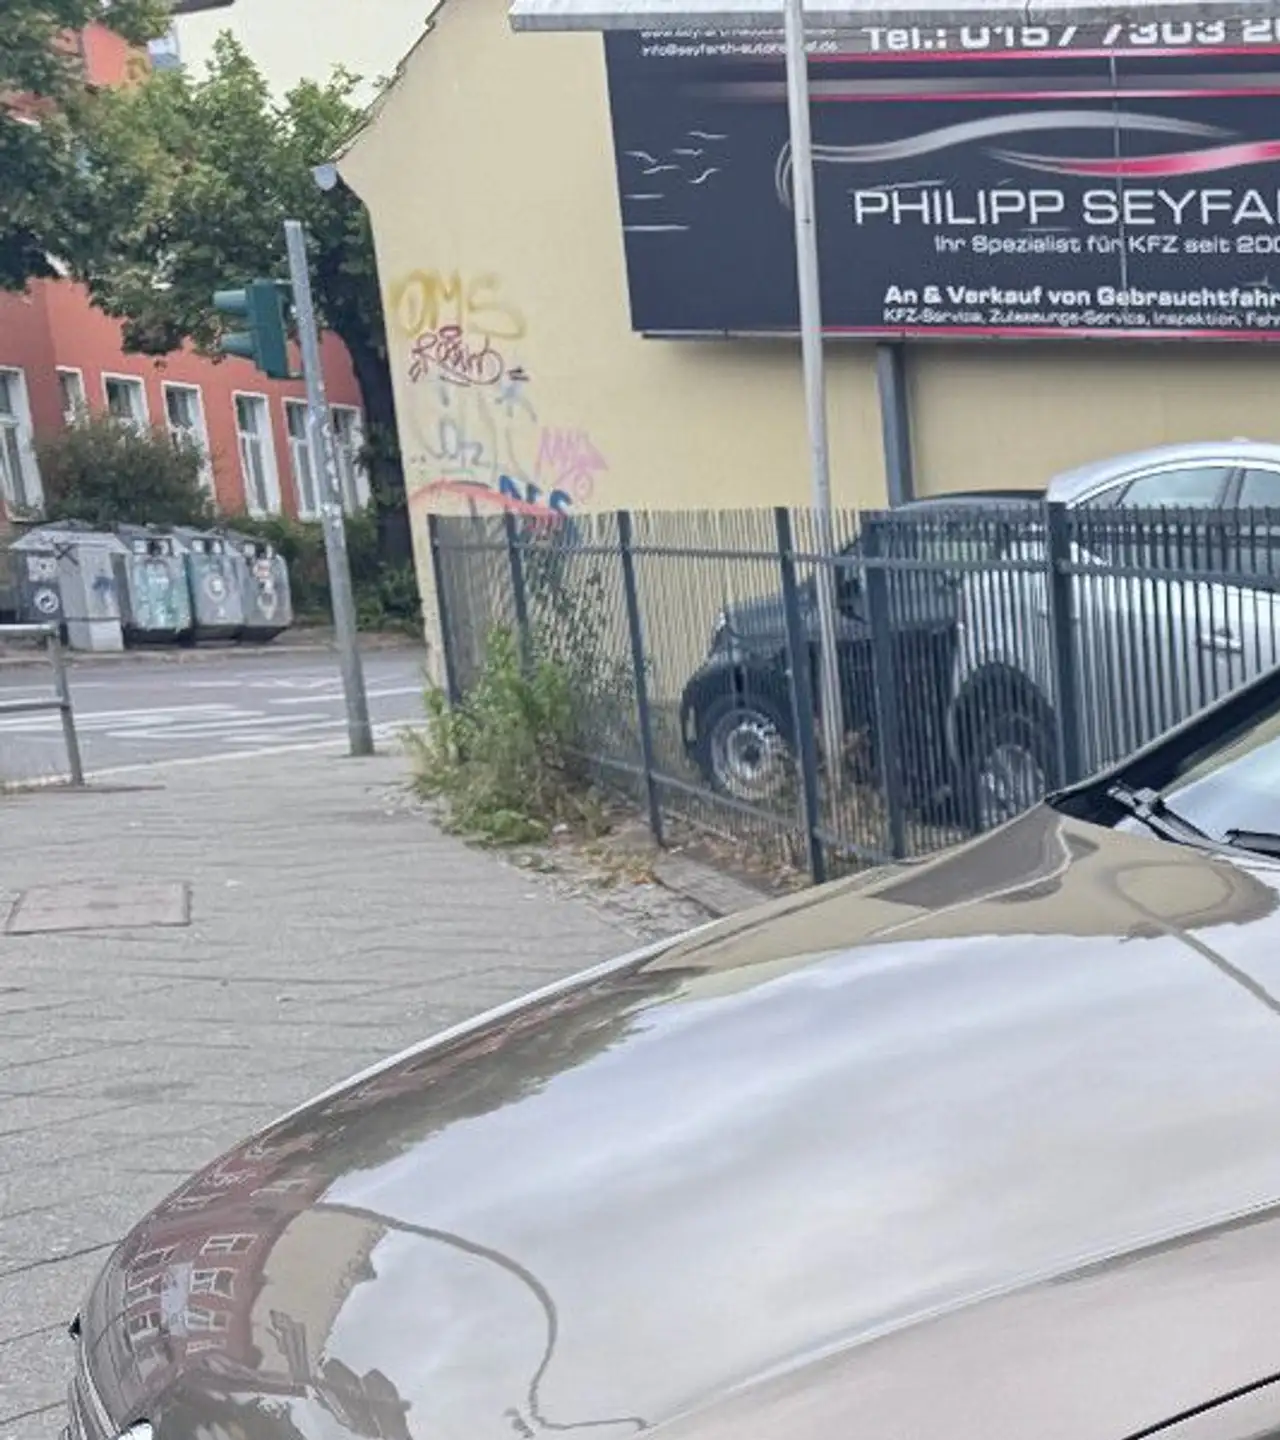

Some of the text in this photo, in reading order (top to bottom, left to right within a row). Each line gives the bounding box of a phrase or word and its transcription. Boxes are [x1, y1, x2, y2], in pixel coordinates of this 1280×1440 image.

[861, 26, 947, 50] Tel.:
[854, 189, 1066, 225] PHILIPP
[934, 235, 966, 252] Ihr
[971, 234, 1082, 255] Spezialist
[1087, 234, 1122, 252] für
[1128, 235, 1179, 253] KFZ
[1184, 234, 1231, 253] seit
[884, 285, 918, 304] An
[923, 285, 942, 304] &
[946, 285, 1043, 305] Verkauf
[1048, 289, 1091, 305] von
